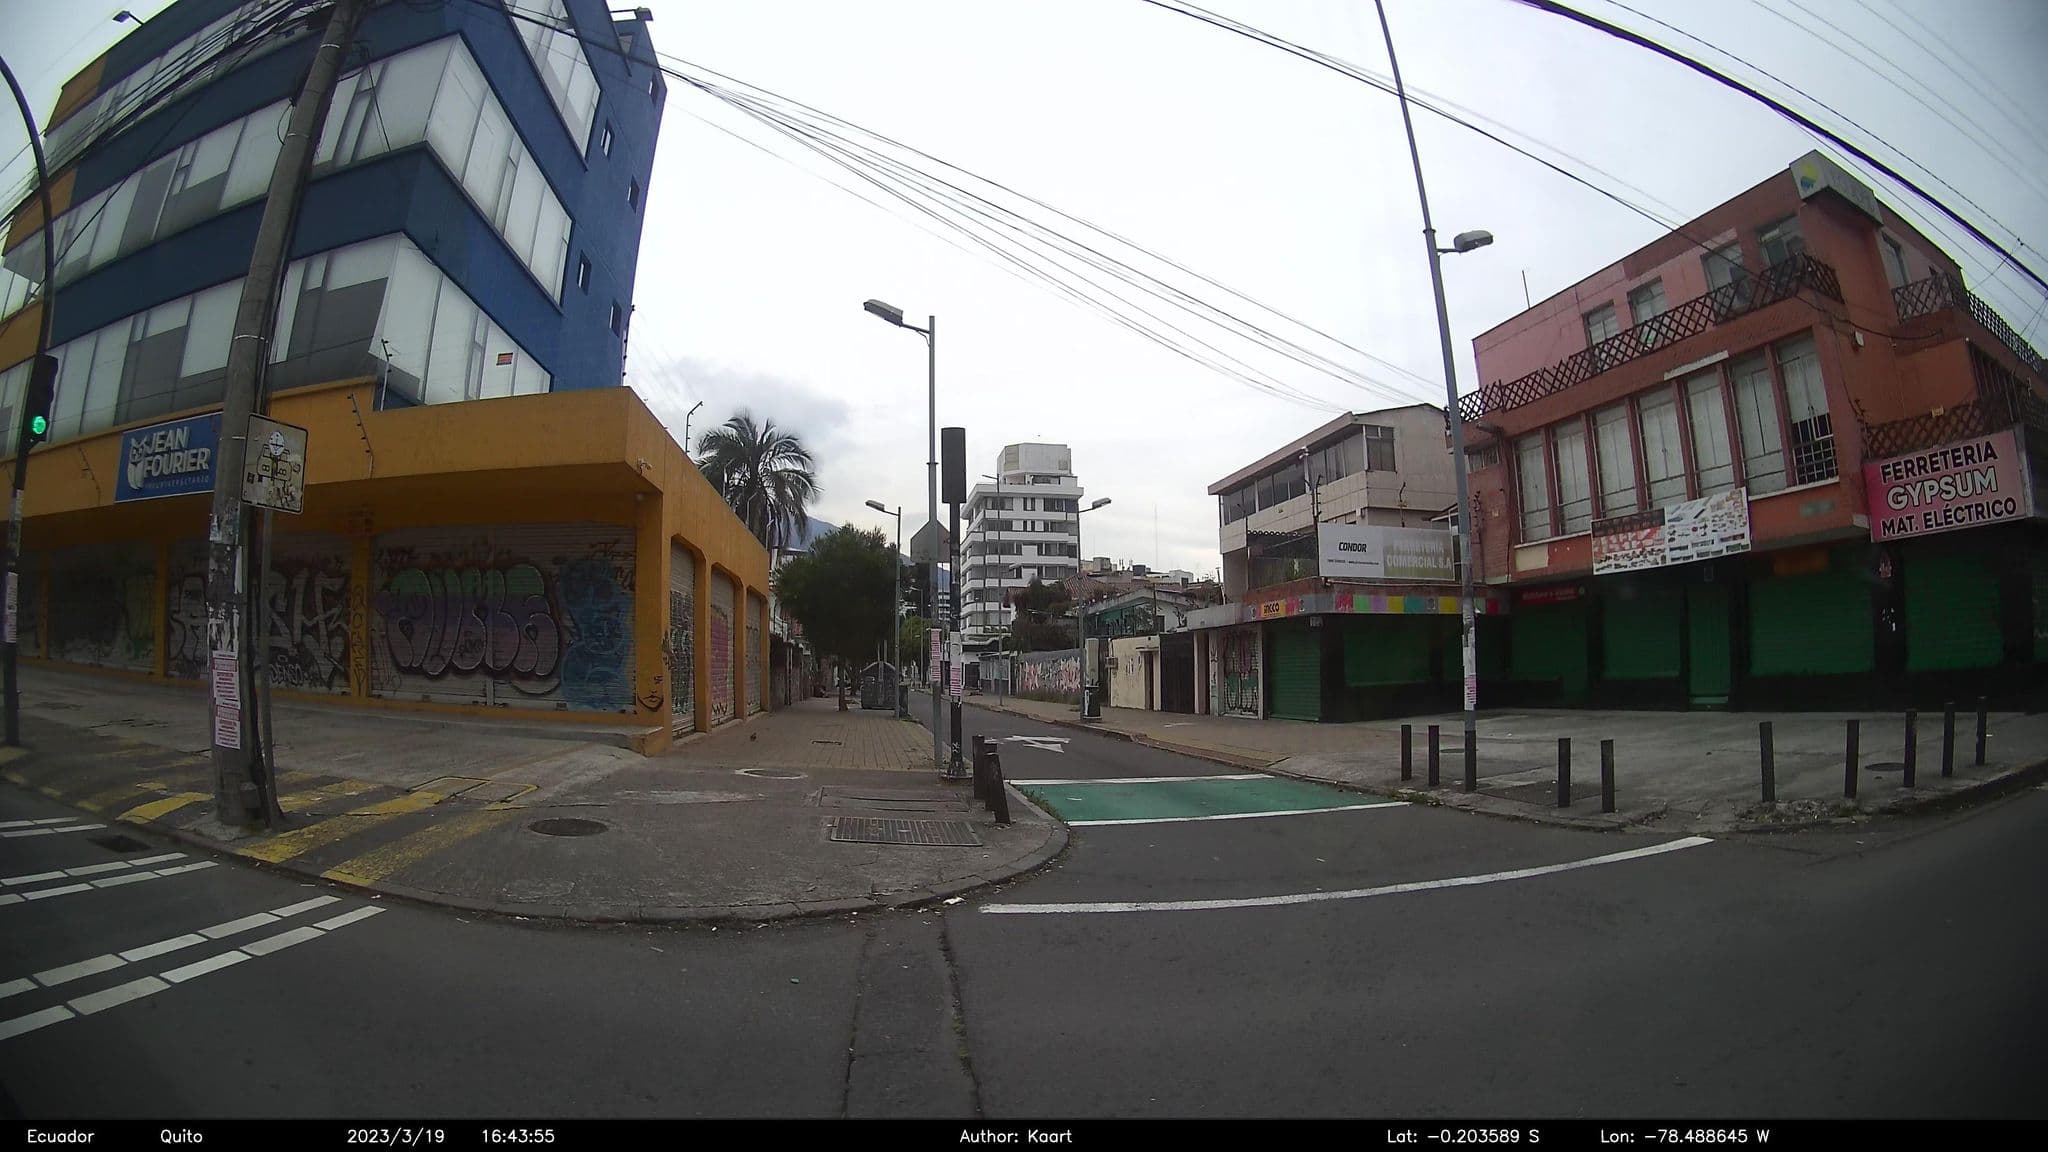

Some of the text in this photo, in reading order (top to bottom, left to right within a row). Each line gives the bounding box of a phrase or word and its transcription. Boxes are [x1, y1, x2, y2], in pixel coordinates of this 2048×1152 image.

[147, 426, 190, 454] JEAN
[143, 448, 211, 479] FOURIER
[1880, 440, 1998, 484] FERRETERIA
[1887, 465, 1998, 511] GYPSUM
[1881, 496, 2017, 537] MAT. ELÉCTRICO
[1338, 541, 1367, 553] CONDOR
[1386, 554, 1437, 569] COMERCIAL
